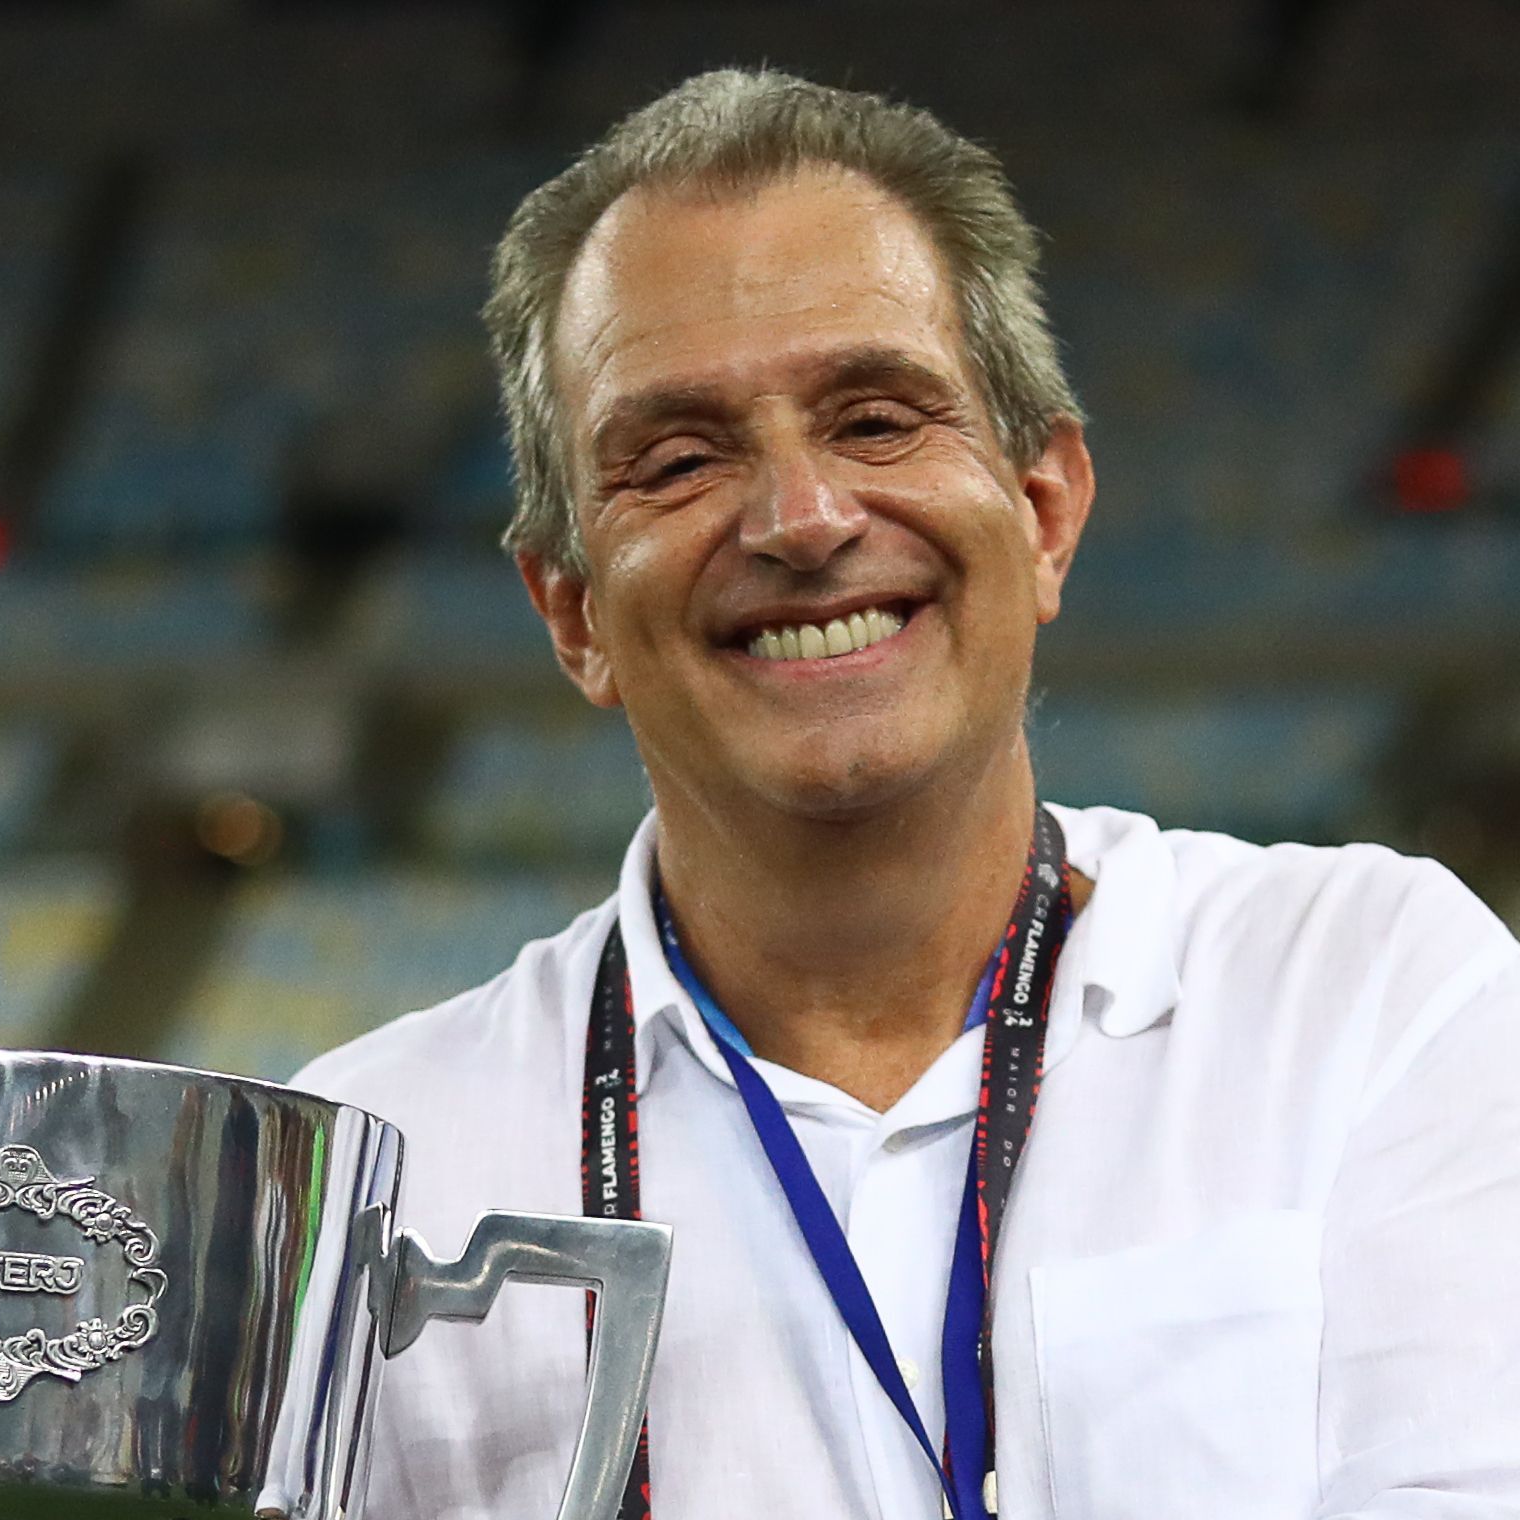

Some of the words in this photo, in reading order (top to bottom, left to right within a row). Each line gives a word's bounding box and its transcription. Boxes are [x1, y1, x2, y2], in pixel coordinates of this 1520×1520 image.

[1013, 918, 1045, 1004] FLAMENGO
[1005, 1047, 1021, 1113] MAIOR
[600, 1096, 618, 1200] FLAMENGO
[1003, 1139, 1013, 1168] DO
